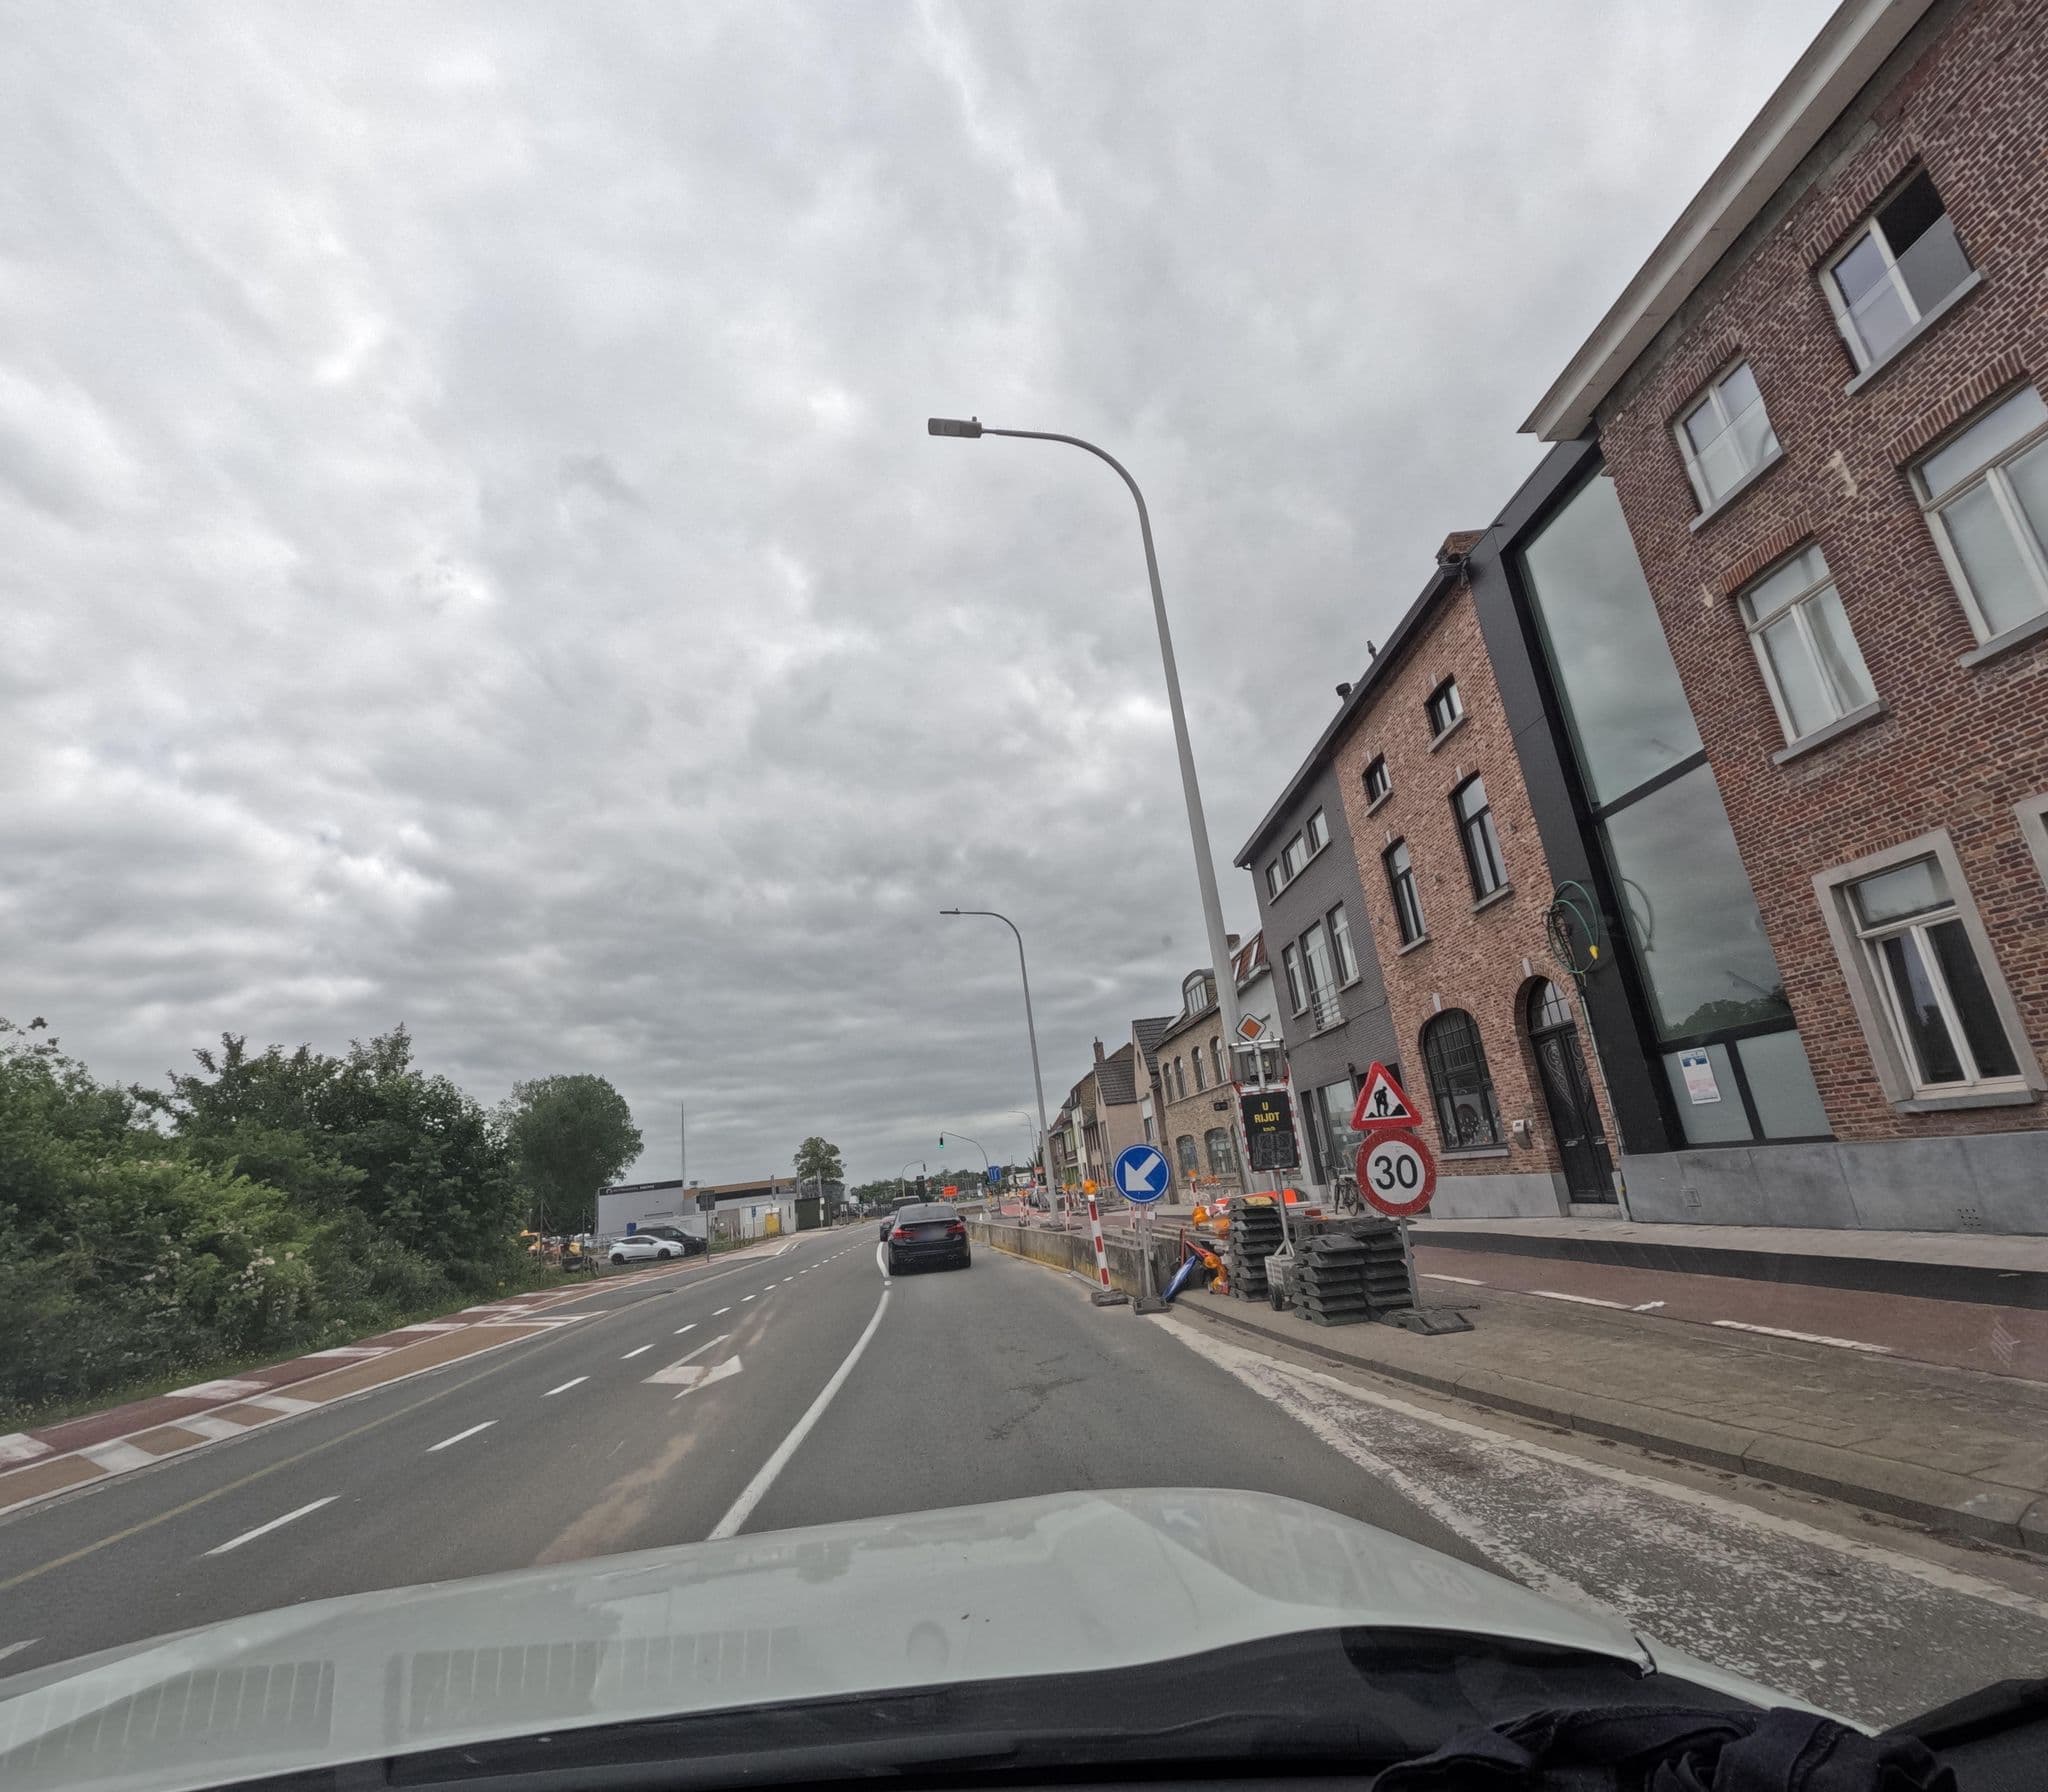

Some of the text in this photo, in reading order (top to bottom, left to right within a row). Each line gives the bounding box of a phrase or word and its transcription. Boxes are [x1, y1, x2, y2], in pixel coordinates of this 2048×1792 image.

[1262, 1101, 1269, 1111] U
[1254, 1111, 1280, 1124] RIJDT
[1374, 1154, 1418, 1190] 30
